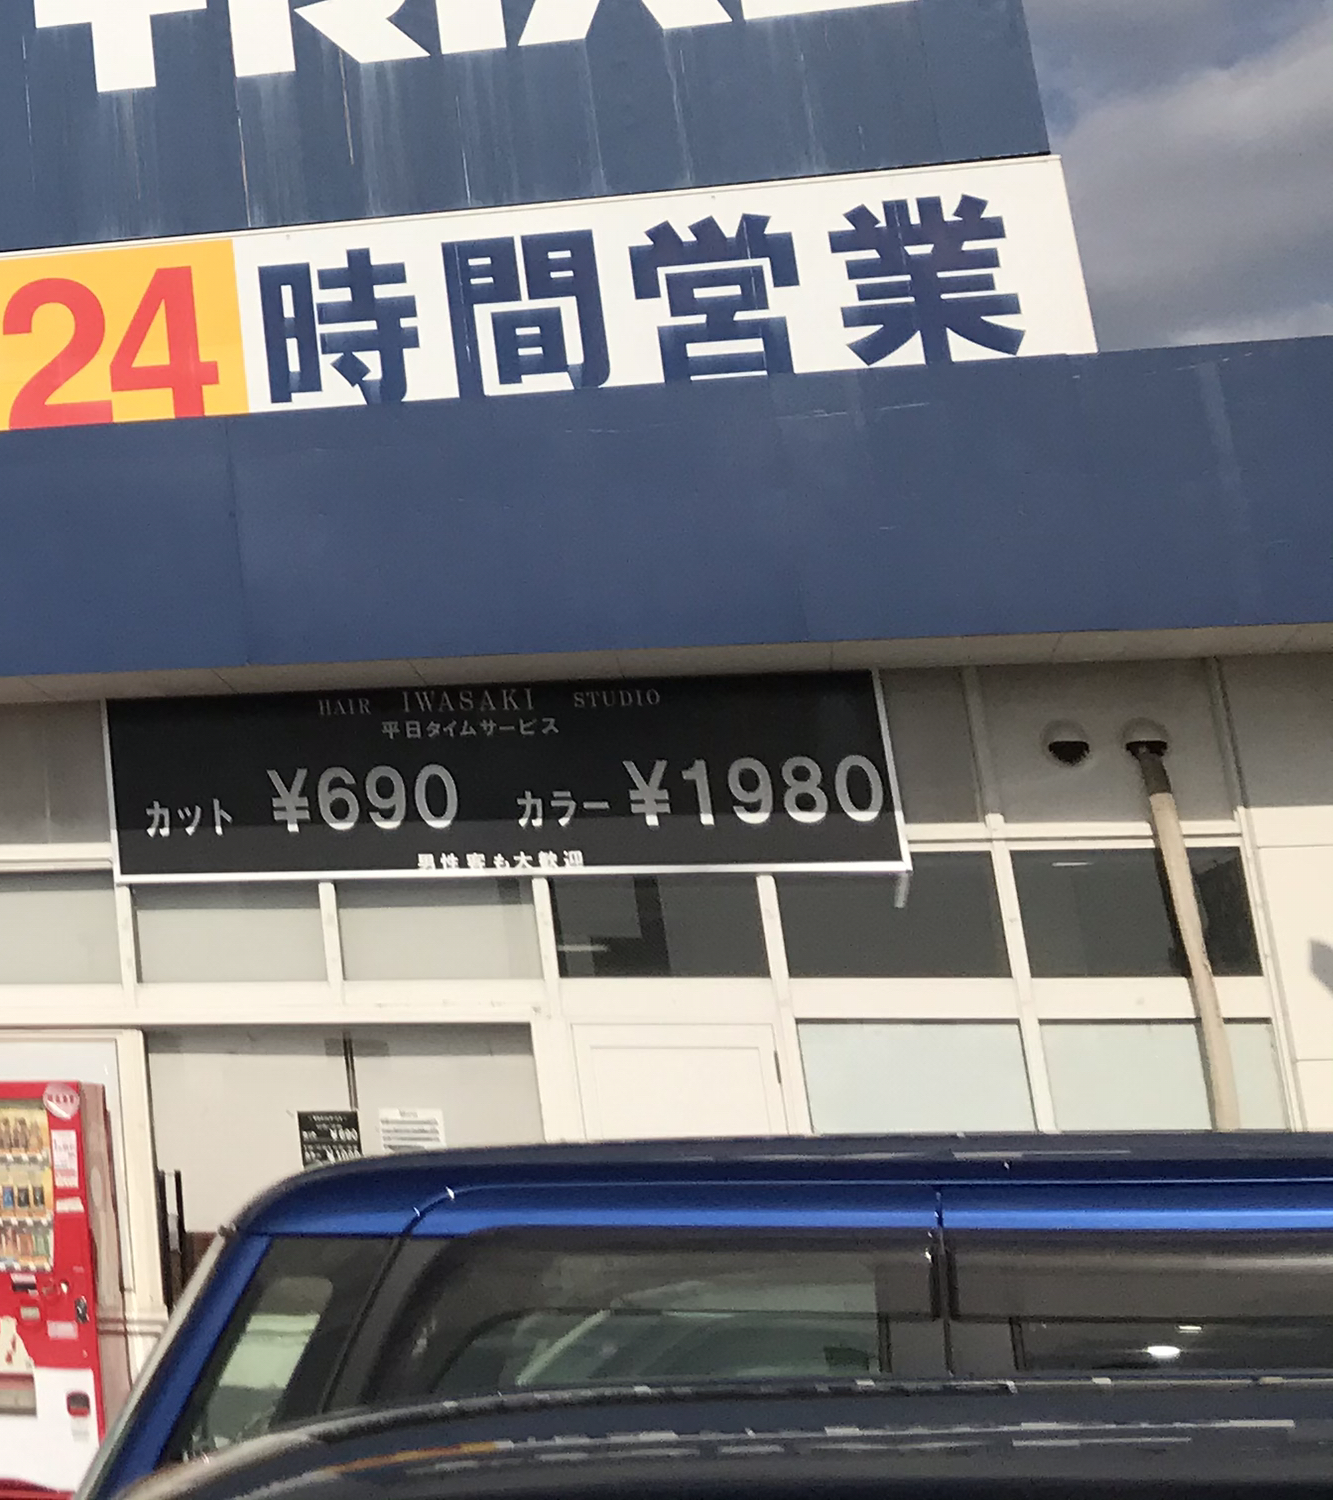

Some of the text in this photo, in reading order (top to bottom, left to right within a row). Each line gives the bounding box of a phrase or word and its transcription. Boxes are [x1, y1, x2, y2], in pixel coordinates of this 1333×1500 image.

[319, 688, 661, 716] HAIR IWASAKI STUDIO
[381, 717, 560, 740] 平日タイムサービス
[145, 754, 884, 837] カット ¥690 カラー ¥1980
